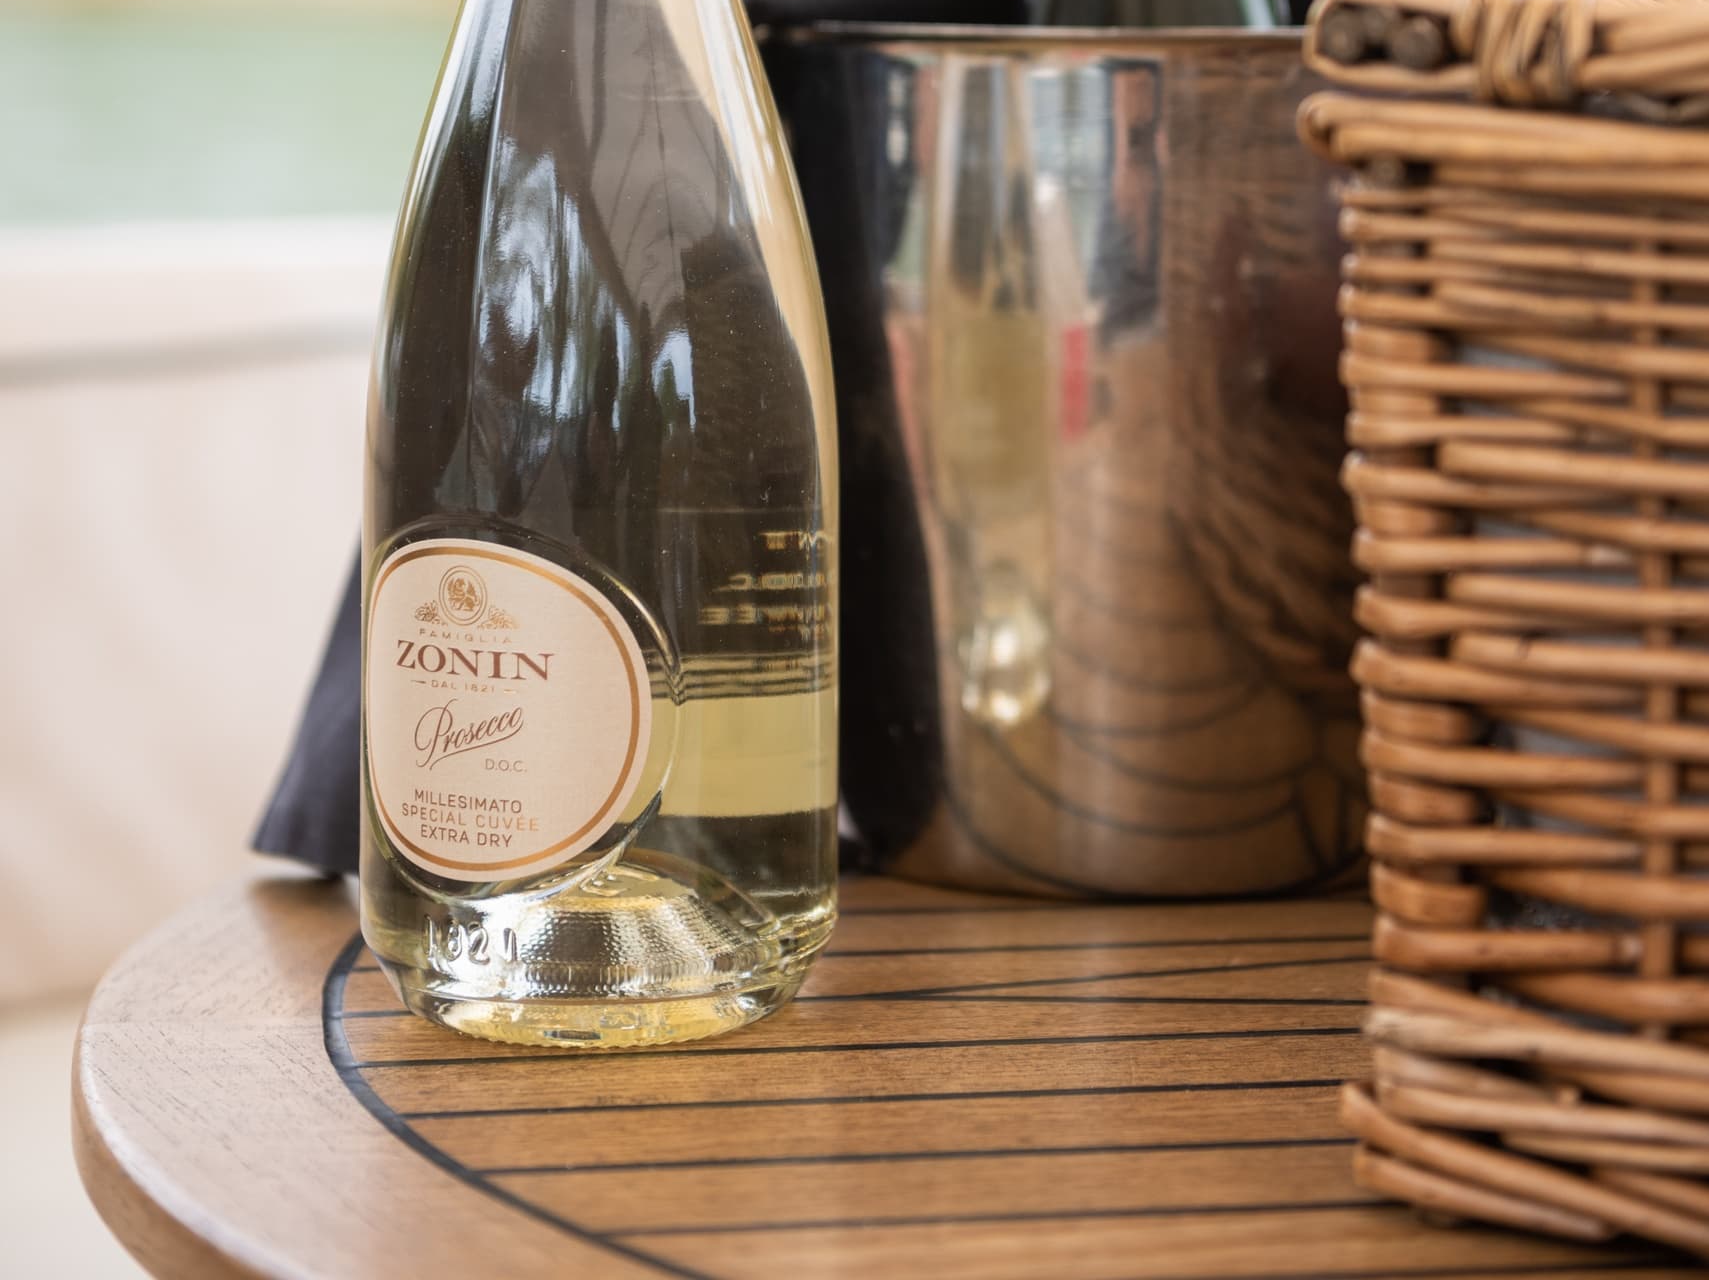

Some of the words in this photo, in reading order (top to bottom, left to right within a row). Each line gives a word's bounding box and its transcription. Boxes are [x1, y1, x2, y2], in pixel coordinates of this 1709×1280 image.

[419, 628, 512, 643] FAMIGLIA
[396, 639, 555, 681] ZONIN
[431, 679, 457, 690] DAL
[414, 698, 524, 770] Prosecco
[484, 758, 527, 773] D.O.C.
[414, 788, 522, 814] MILLESIMATO
[401, 803, 464, 828] SPECIAL
[420, 824, 470, 845] EXTRA
[476, 833, 512, 848] DRY
